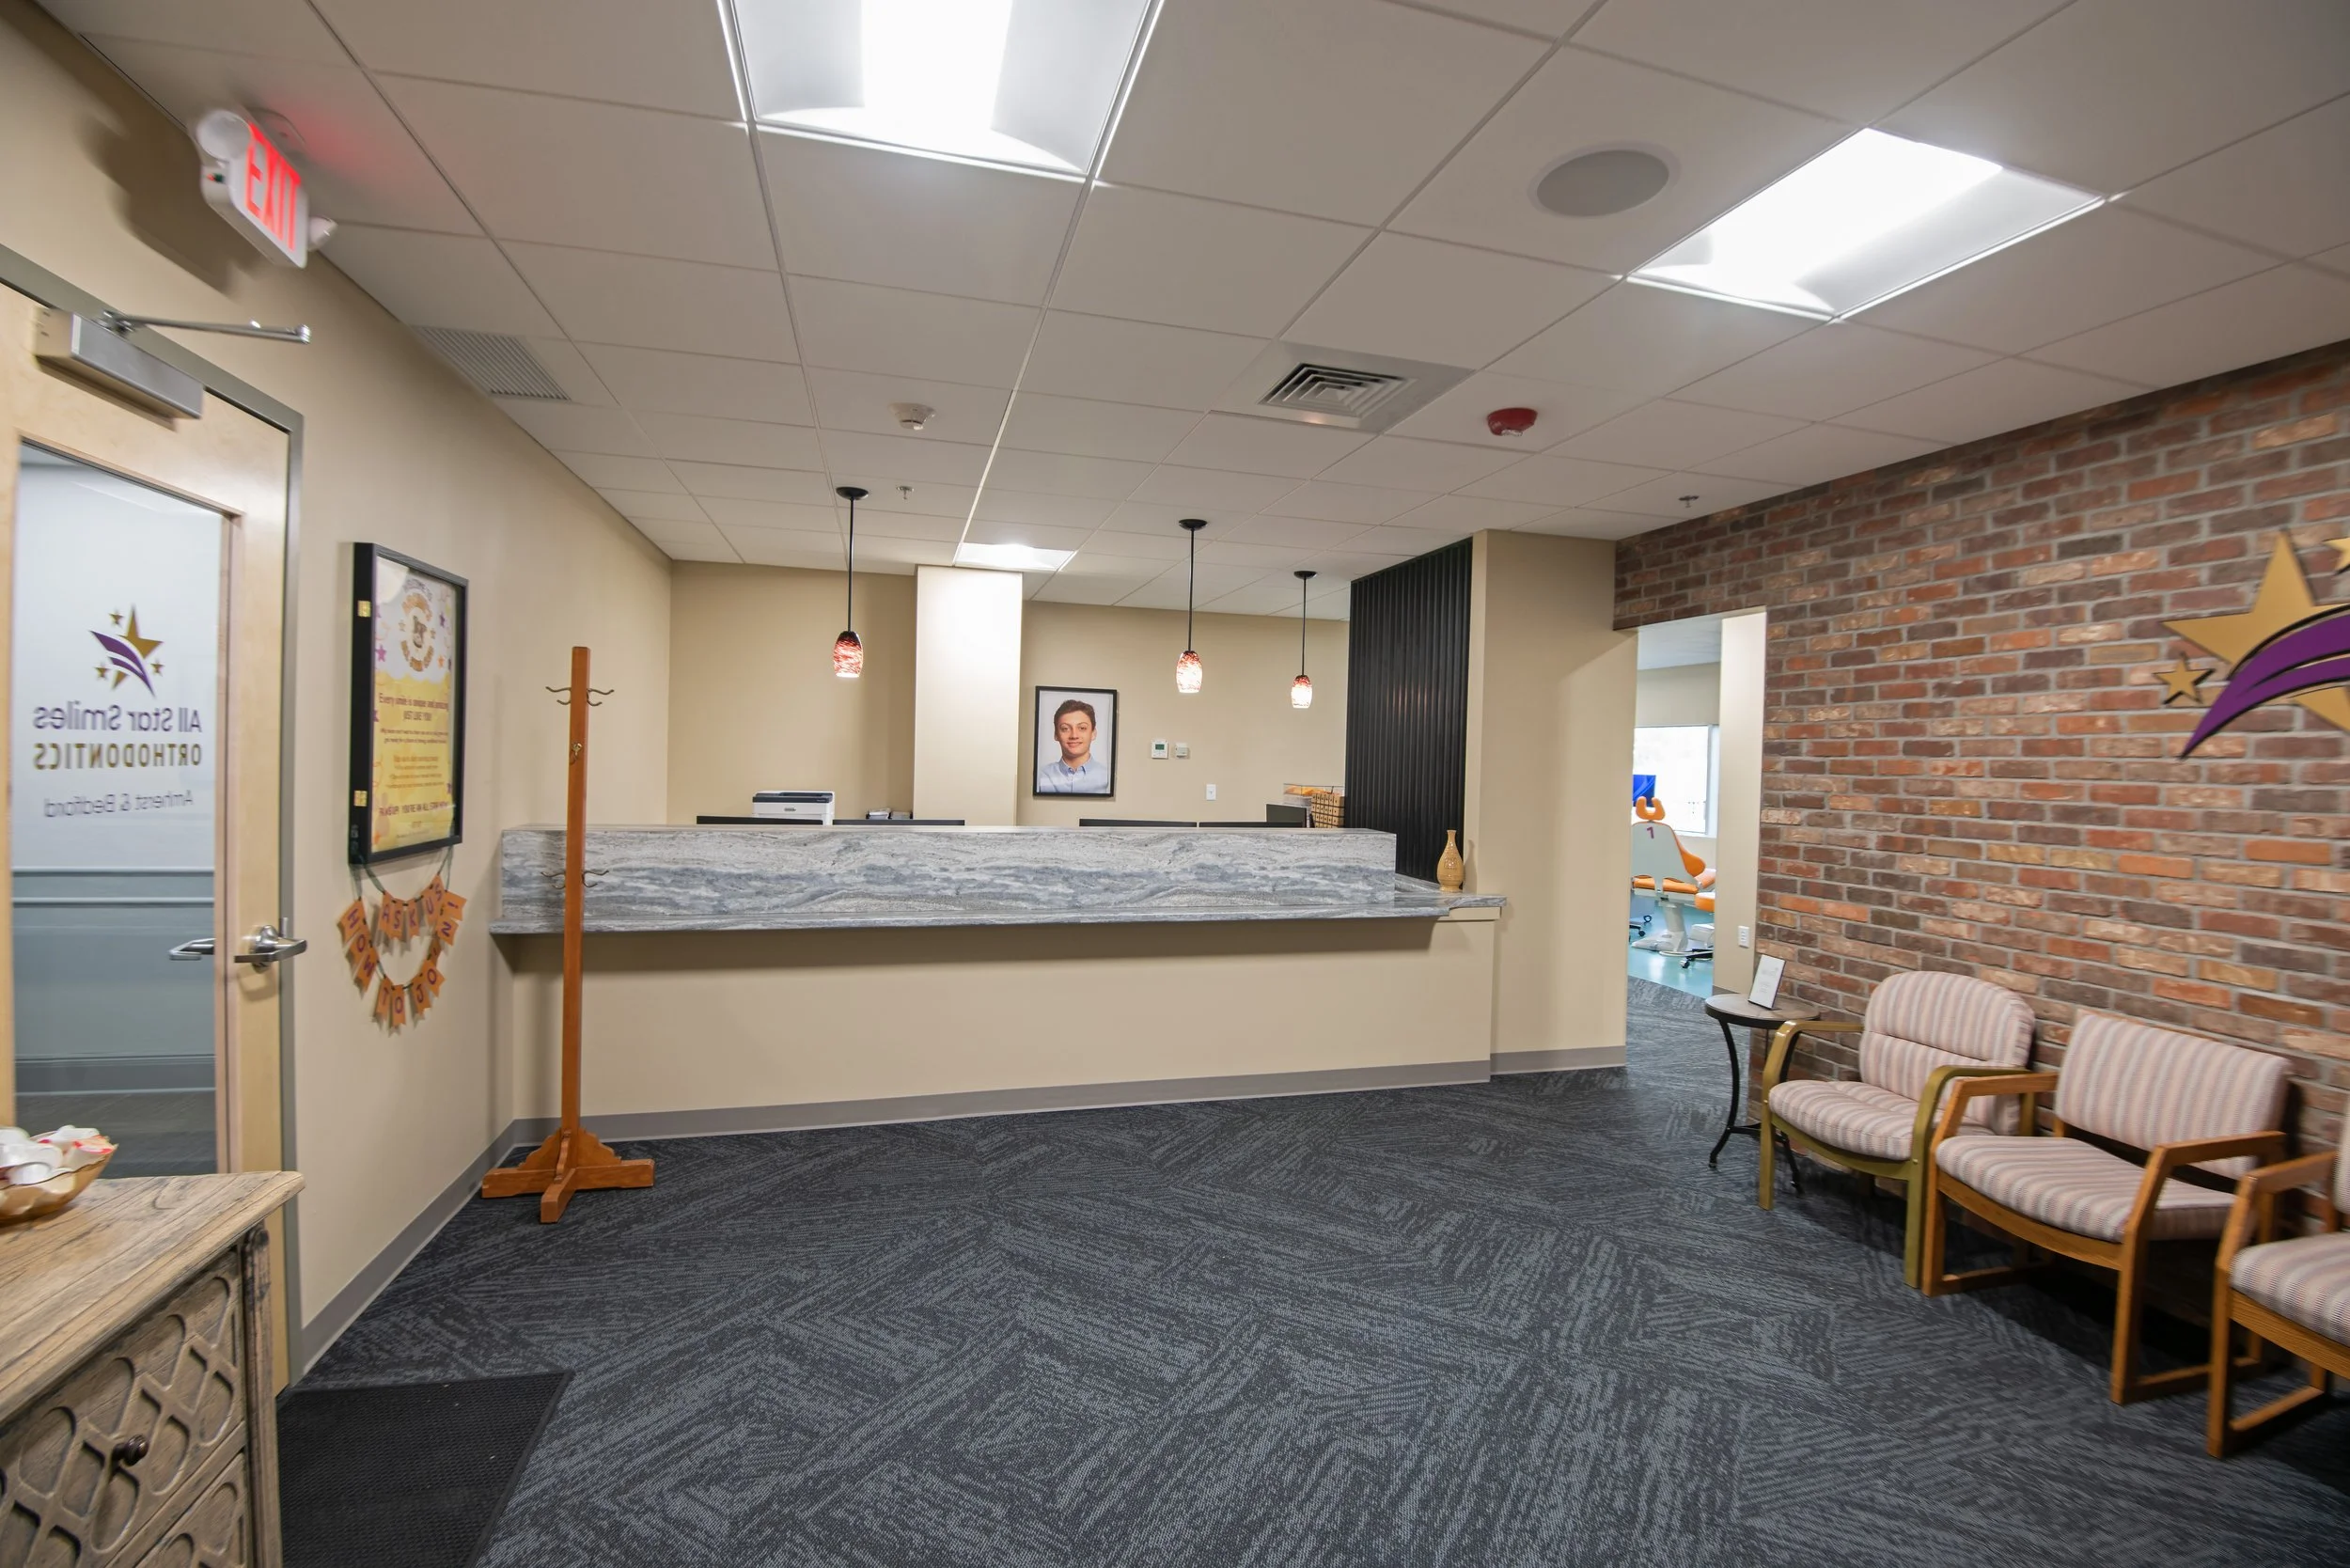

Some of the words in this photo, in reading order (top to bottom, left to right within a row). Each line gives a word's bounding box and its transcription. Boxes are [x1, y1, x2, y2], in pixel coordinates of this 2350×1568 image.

[245, 122, 302, 251] EXIT
[1646, 826, 1654, 839] 1
[382, 902, 417, 930] ASK
[382, 988, 404, 1014] TO
